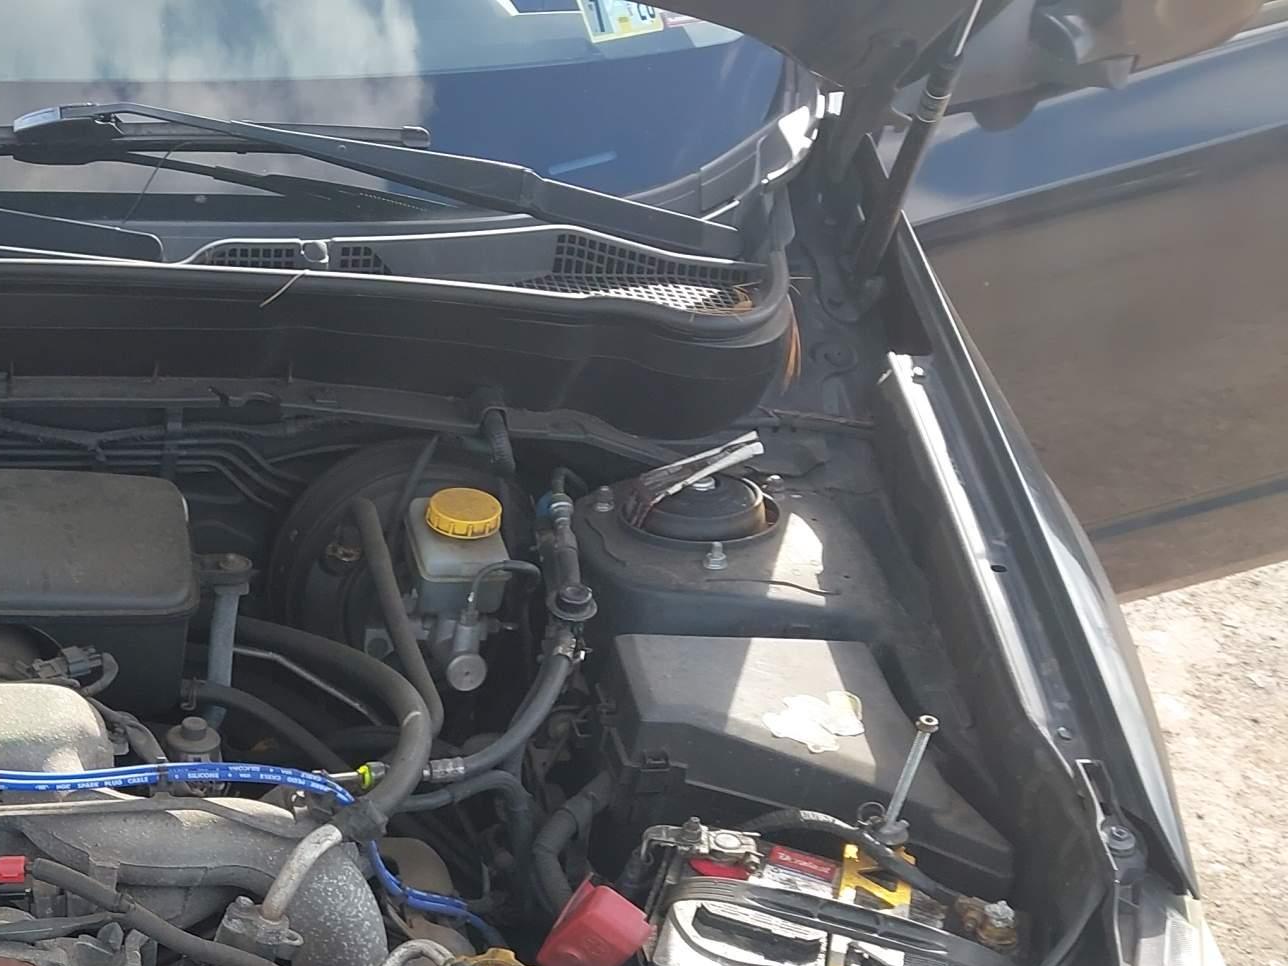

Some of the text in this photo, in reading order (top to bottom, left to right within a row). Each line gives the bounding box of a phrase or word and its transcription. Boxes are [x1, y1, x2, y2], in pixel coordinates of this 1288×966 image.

[77, 781, 99, 789] SPARK
[103, 780, 123, 788] PLUG
[127, 776, 149, 785] CABLE
